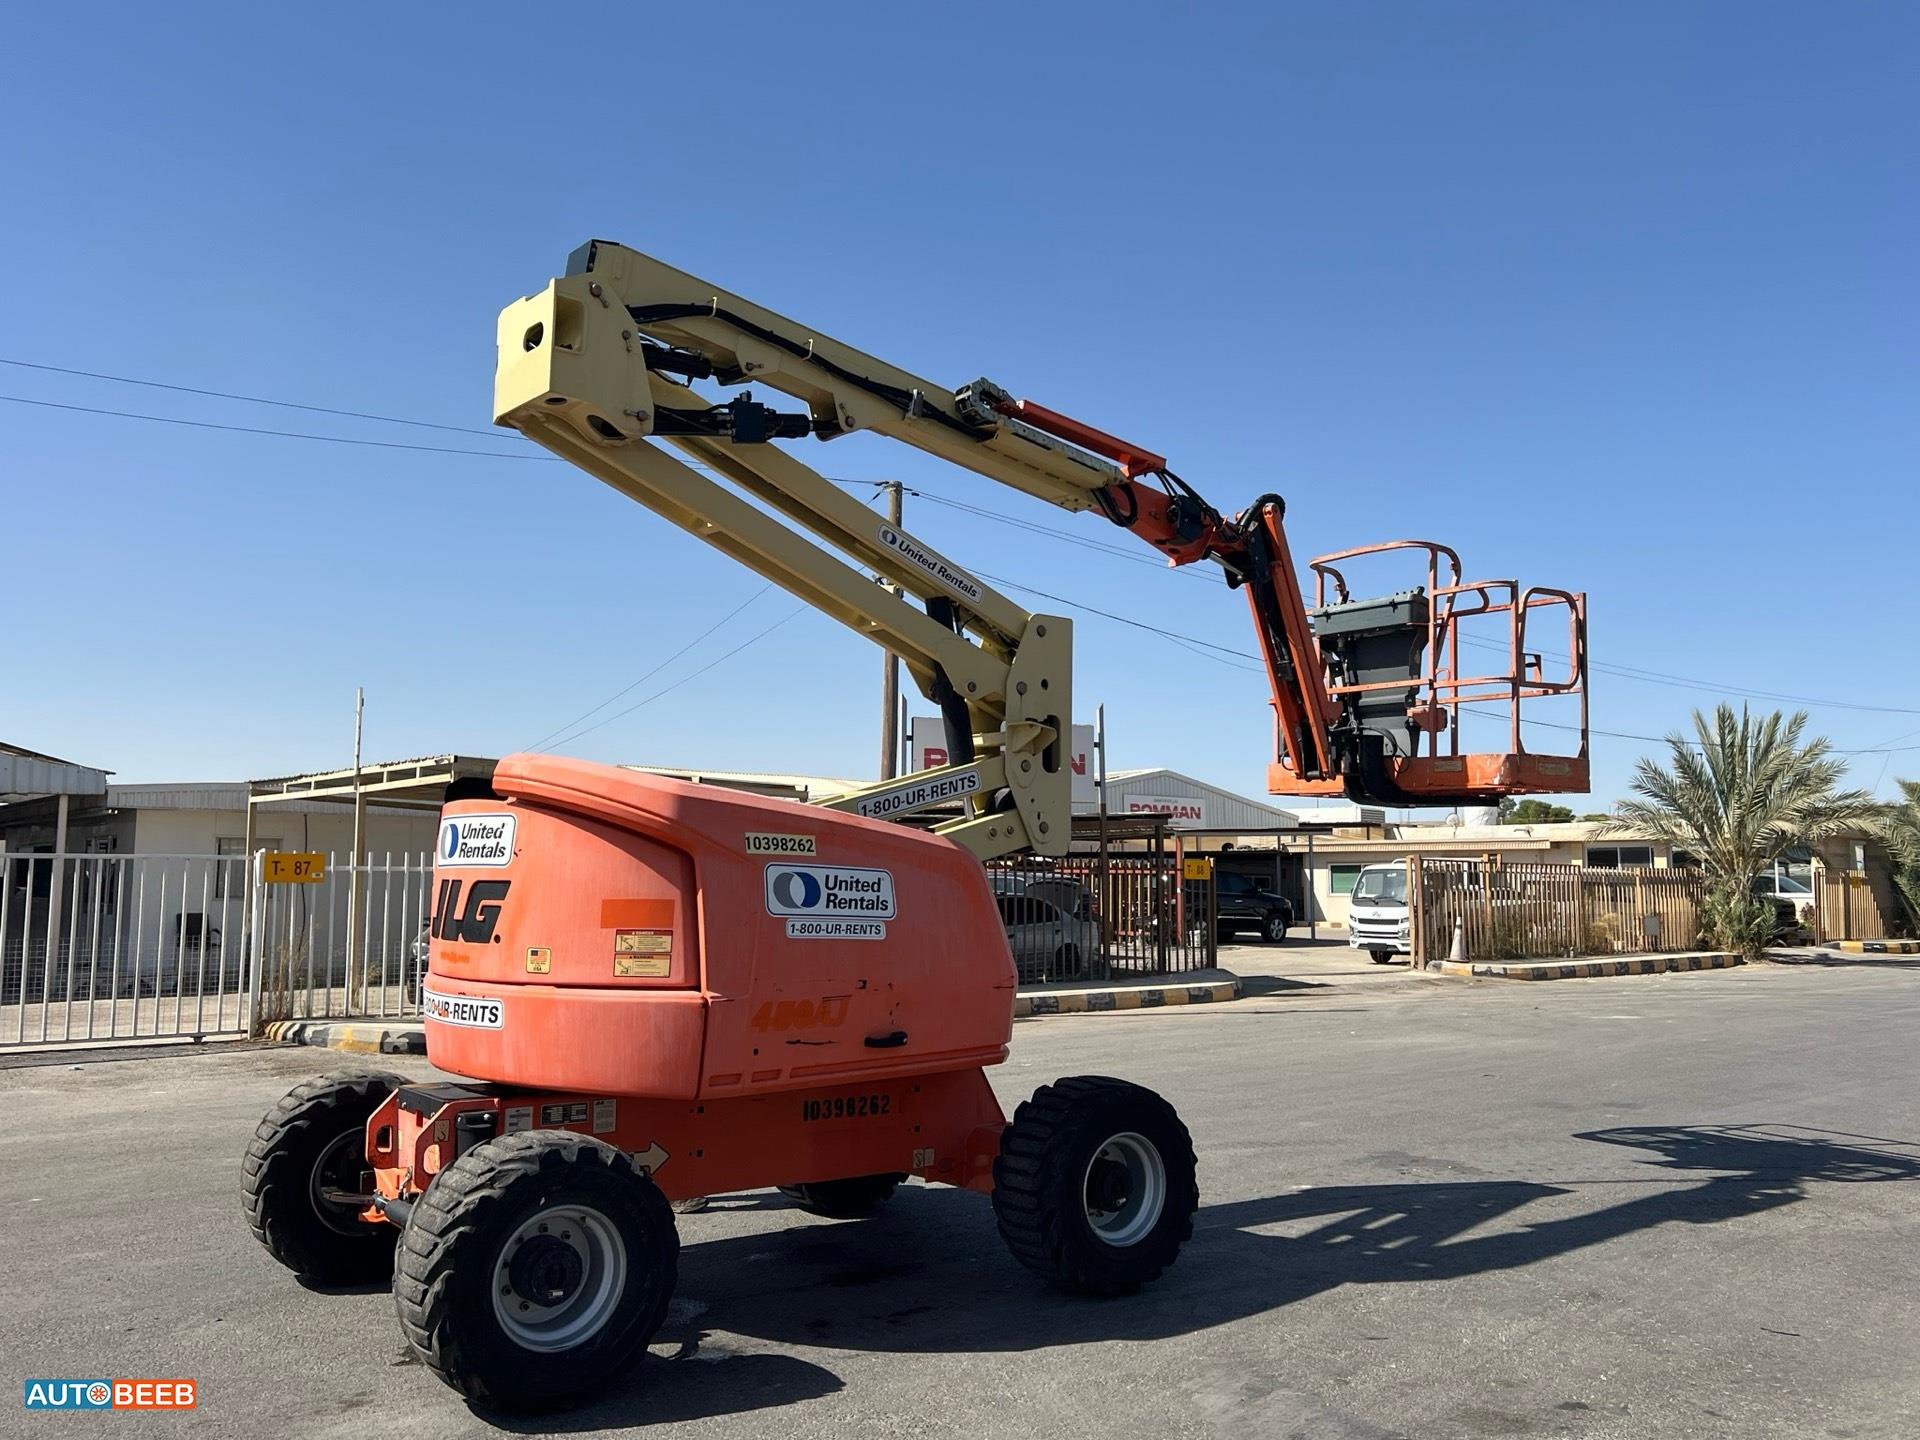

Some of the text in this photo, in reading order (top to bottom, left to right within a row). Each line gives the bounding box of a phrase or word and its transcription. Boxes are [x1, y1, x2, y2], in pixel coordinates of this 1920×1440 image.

[899, 541, 978, 597] United Rentals
[860, 774, 977, 817] 1-800-UR-RENTS
[461, 822, 506, 840] United
[459, 841, 507, 859] Rentals
[745, 836, 815, 853] 10398262
[272, 861, 311, 875] T- 87
[824, 874, 883, 893] United
[825, 893, 889, 912] Rentals
[789, 923, 883, 936] 1-800-UR-RENTS
[803, 1095, 890, 1121] 10398262
